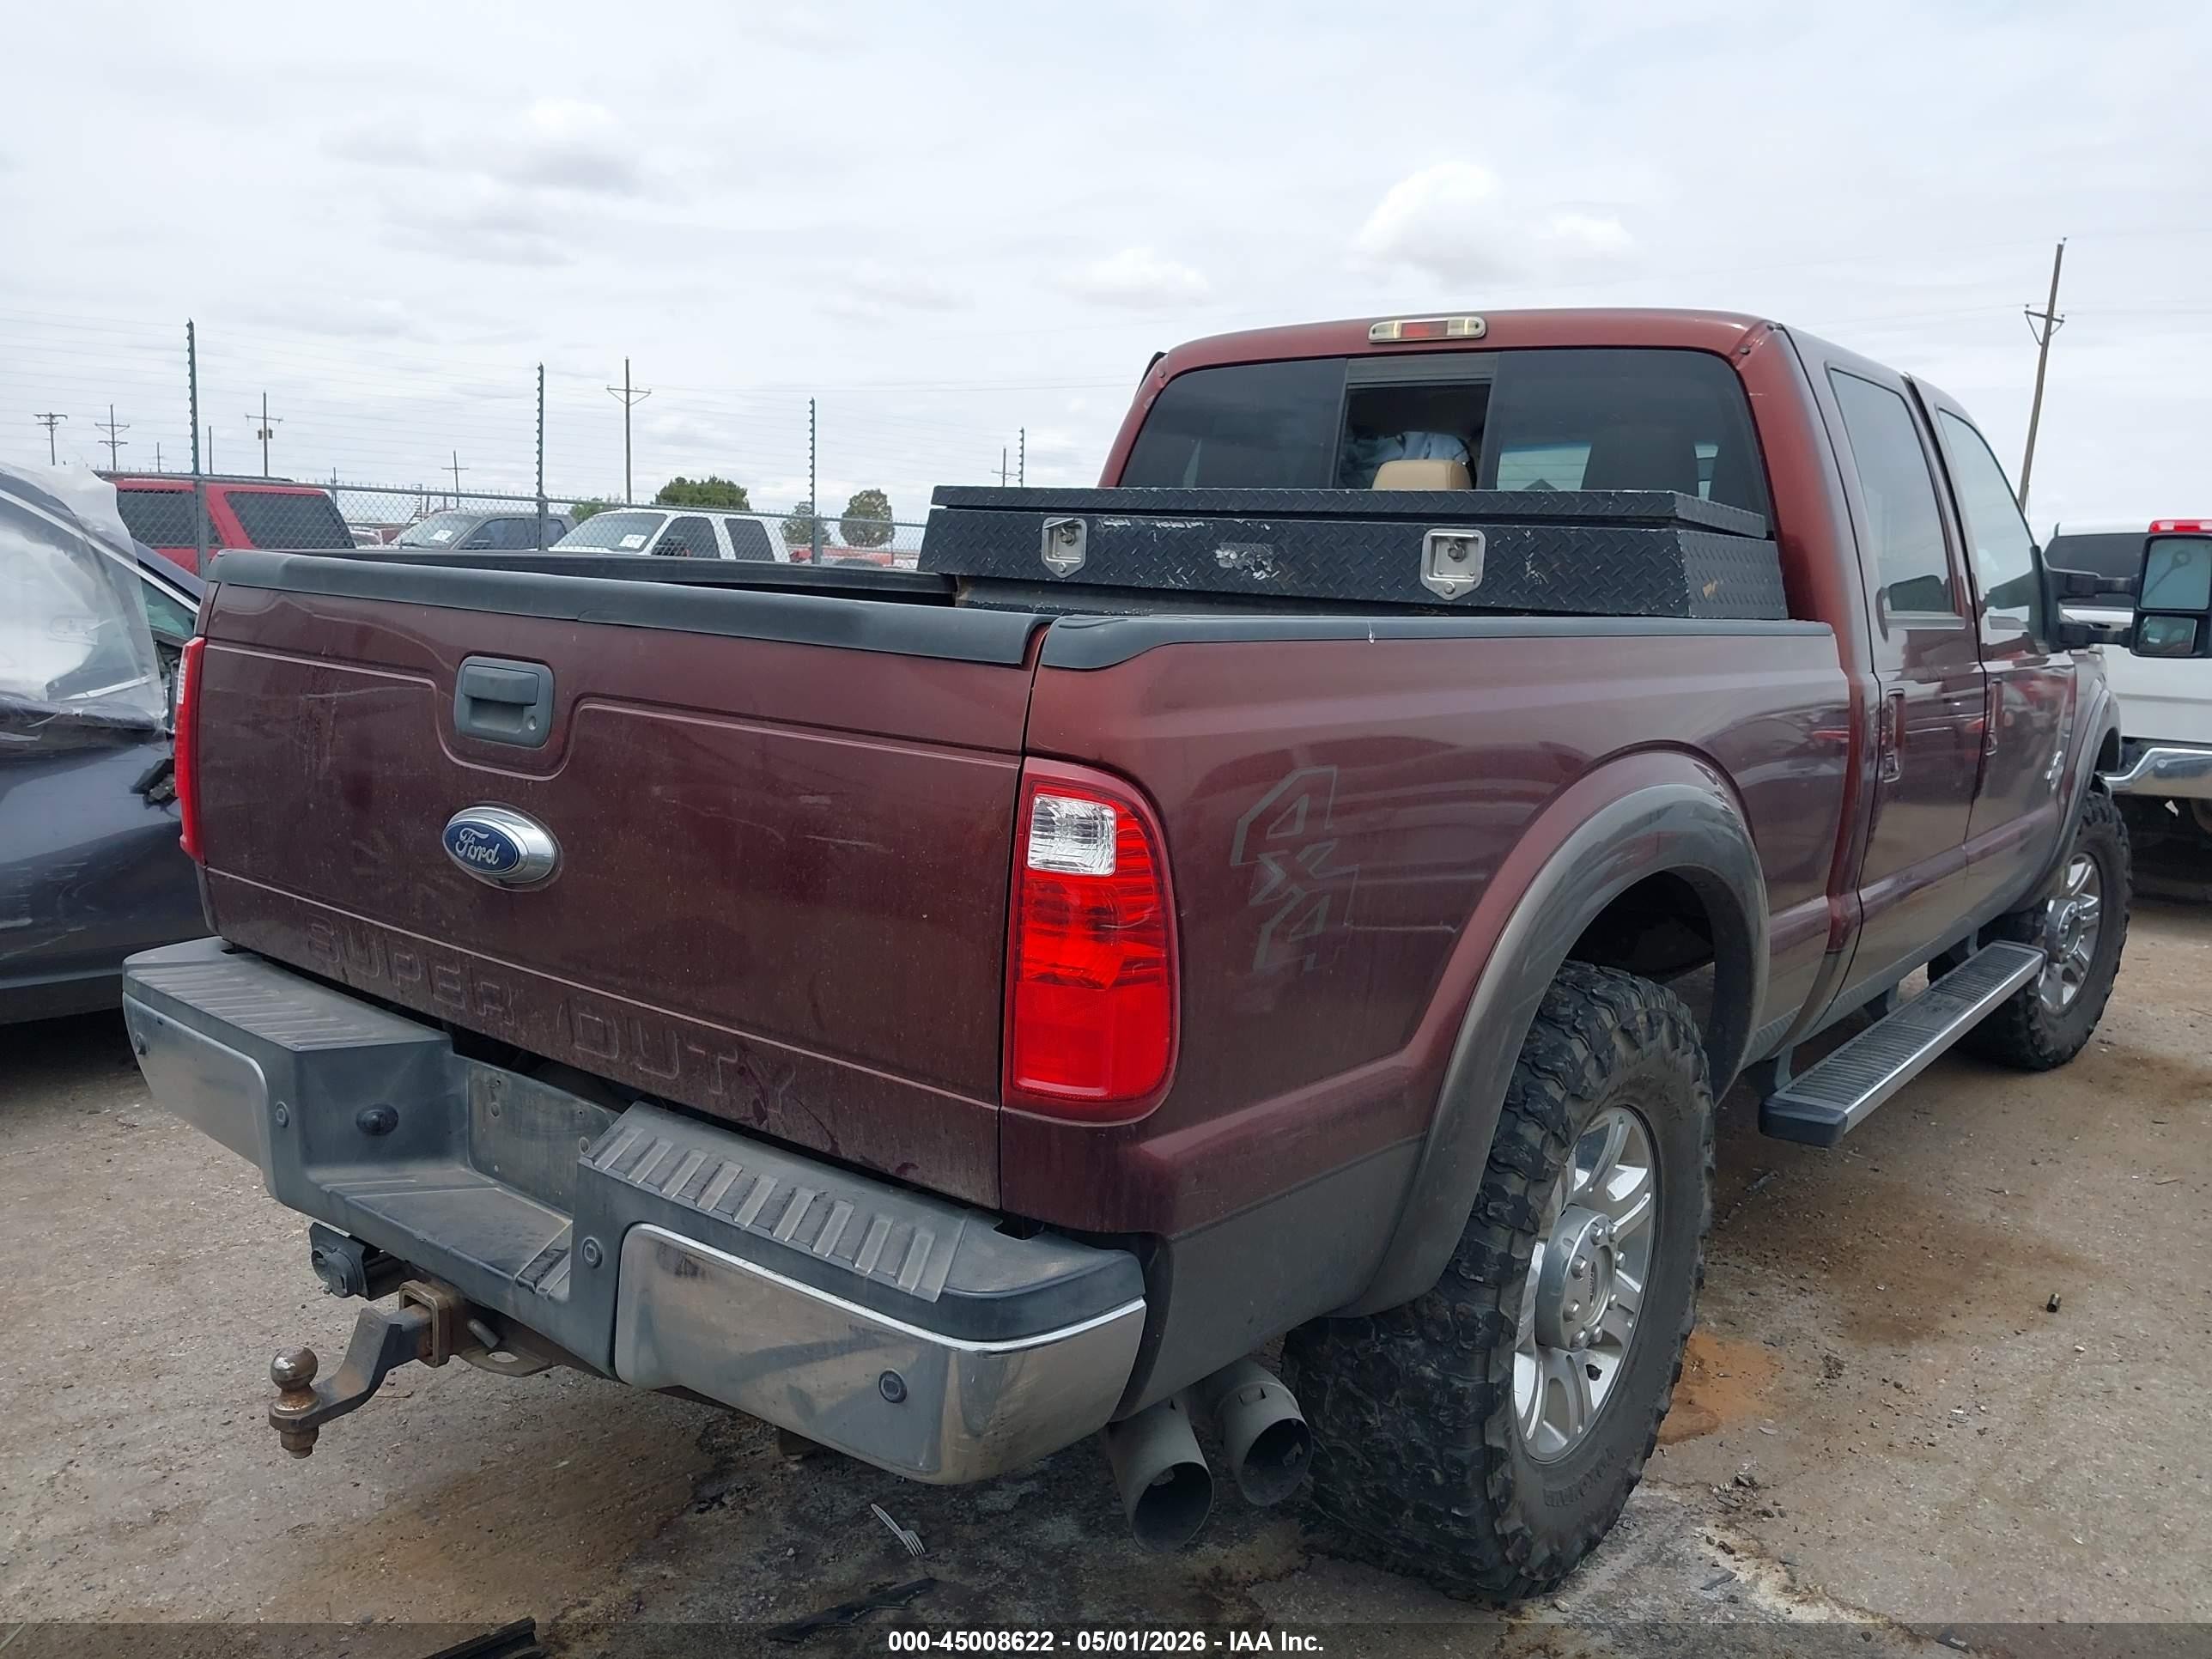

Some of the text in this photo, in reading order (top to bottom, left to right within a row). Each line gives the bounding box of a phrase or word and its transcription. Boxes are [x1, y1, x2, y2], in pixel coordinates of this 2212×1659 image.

[454, 826, 501, 866] Ford
[306, 911, 798, 1118] SUPER DUTY
